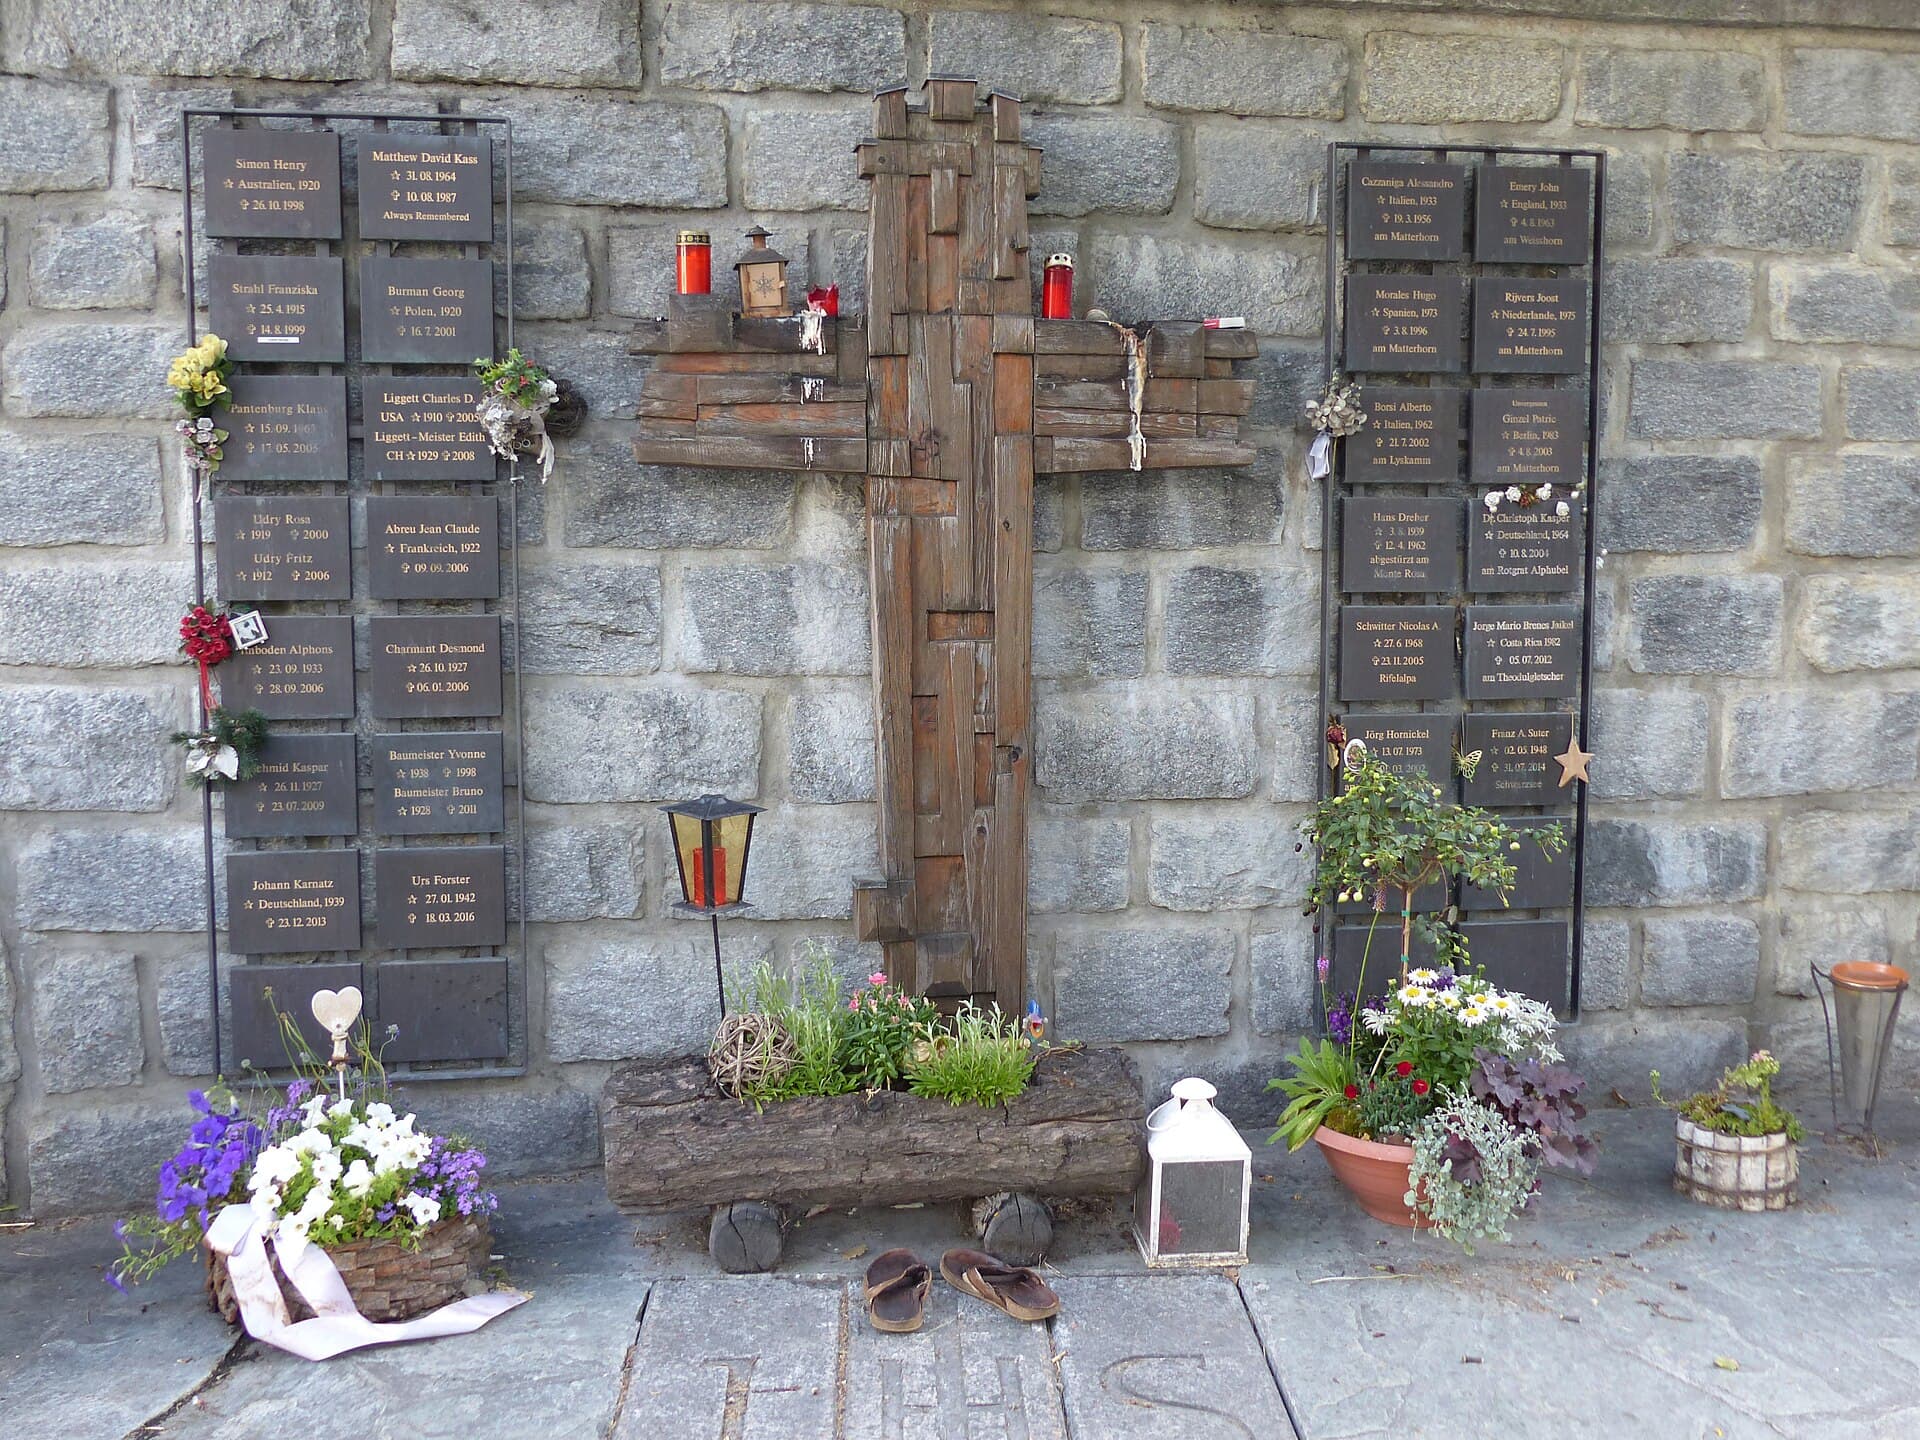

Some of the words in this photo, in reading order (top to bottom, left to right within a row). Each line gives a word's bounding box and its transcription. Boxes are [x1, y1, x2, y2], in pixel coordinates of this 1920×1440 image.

[373, 151, 418, 162] Matthew
[421, 152, 451, 163] David
[454, 153, 478, 164] Kass
[236, 159, 270, 169] Simon
[273, 159, 307, 172] Henry
[238, 179, 296, 191] Australien,
[298, 180, 320, 190] 1920
[383, 211, 414, 221] Always
[415, 212, 470, 221] Remembered
[232, 283, 264, 294] Strahl
[268, 284, 318, 295] Franziska
[388, 286, 428, 296] Burman
[432, 286, 465, 299] Georg
[405, 306, 436, 317] Polen,
[441, 306, 462, 316] 1920
[384, 393, 420, 405] Liggett
[422, 393, 461, 404] Charles
[464, 394, 478, 404] D.
[380, 412, 404, 422] USA
[420, 412, 443, 422] 1910
[456, 412, 482, 423] 2005
[459, 432, 486, 442] Edith
[386, 450, 404, 460] CH
[418, 450, 439, 460] 1929
[452, 451, 475, 461] 2008
[385, 524, 416, 534] Abreu
[419, 524, 442, 534] Jean
[444, 524, 480, 534] Claude
[251, 530, 271, 540] 1919
[303, 530, 329, 540] 2000
[461, 543, 480, 553] 1922
[286, 552, 313, 563] Fritz
[252, 571, 272, 581] 1912
[304, 570, 330, 581] 2006
[289, 644, 333, 656] Alphons
[386, 644, 436, 654] Charmant
[439, 643, 485, 653] Desmond
[389, 750, 445, 760] Baumeister
[448, 749, 486, 759] Yvonne
[249, 761, 289, 773] chmid
[292, 762, 329, 774] Kaspar
[409, 768, 429, 778] 1938
[456, 767, 476, 777] 1998
[394, 787, 449, 798] Baumeister
[452, 786, 484, 796] Bruno
[411, 806, 431, 816] 1928
[458, 804, 477, 814] 2011
[252, 880, 290, 890] Johann
[412, 876, 430, 886] Urs
[434, 875, 471, 885] Forster
[258, 898, 323, 909] Deutschland,
[324, 897, 344, 907] 1939
